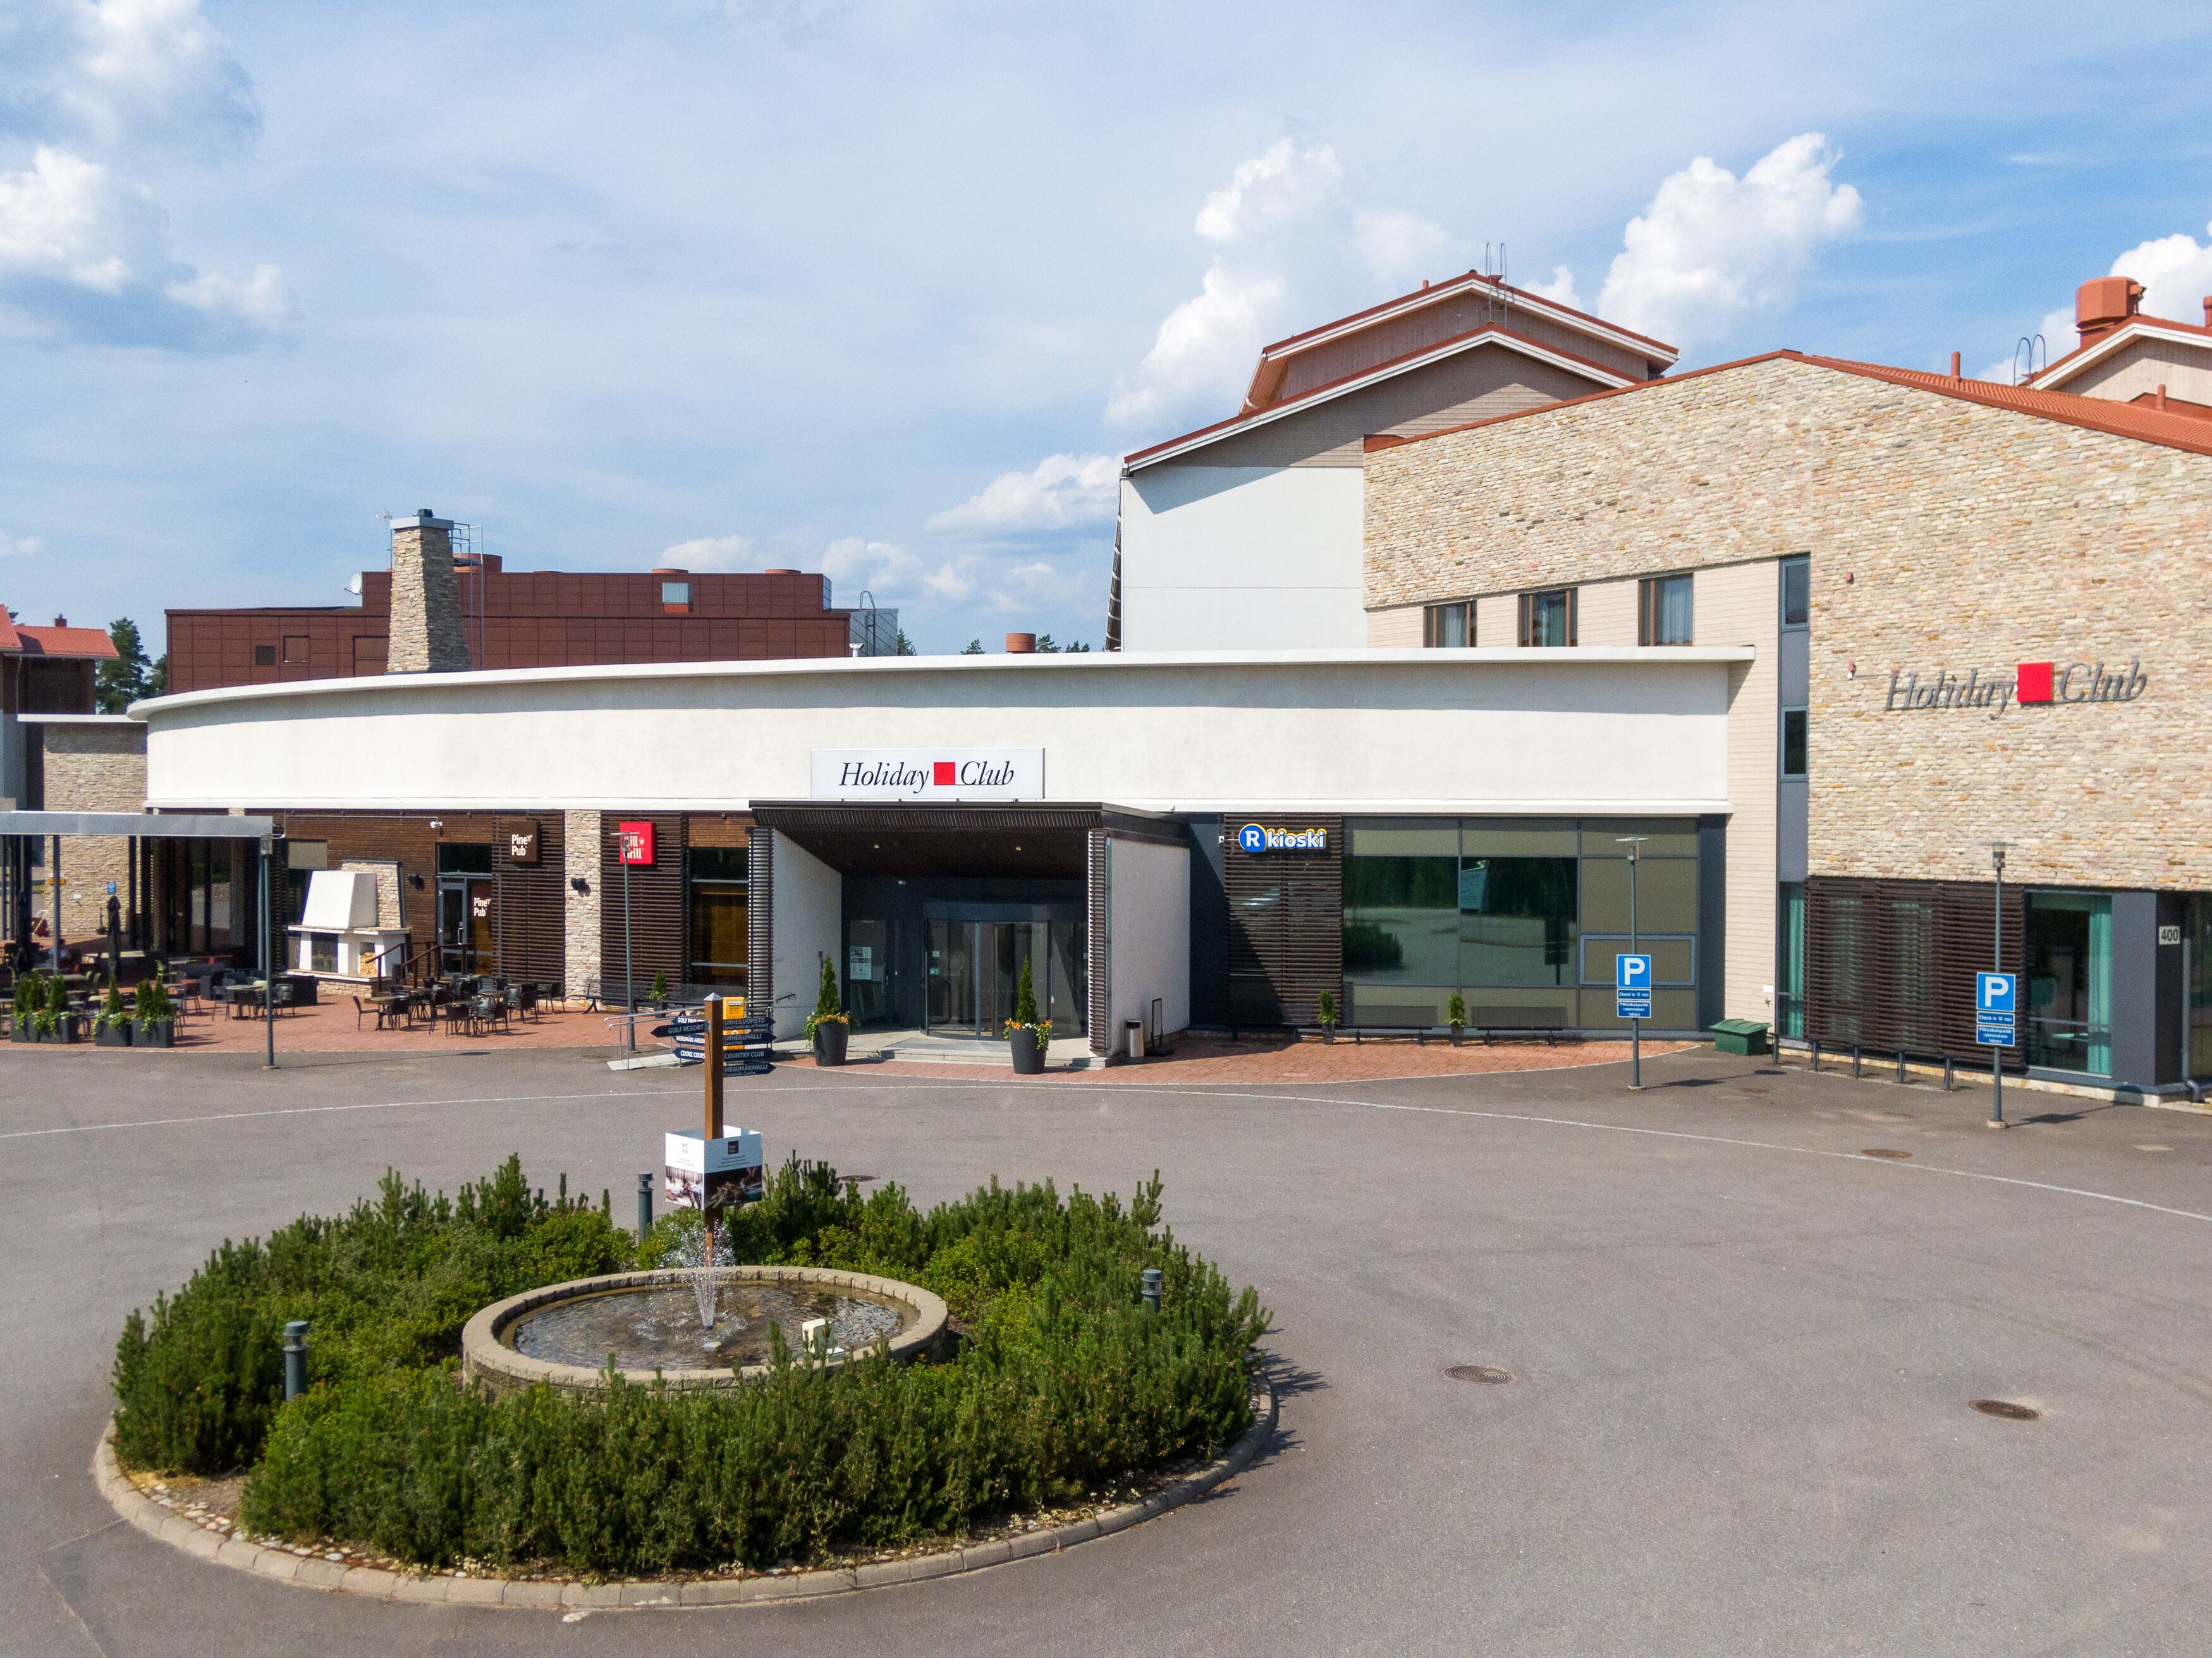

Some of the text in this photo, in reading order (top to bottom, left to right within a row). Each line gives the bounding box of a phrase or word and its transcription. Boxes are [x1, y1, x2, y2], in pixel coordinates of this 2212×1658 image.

[1883, 657, 2148, 721] Holiday Club
[838, 760, 1015, 794] Holiday Club
[511, 834, 529, 845] Pine
[623, 835, 639, 847] ill
[1245, 830, 1324, 848] R kioski
[511, 845, 526, 856] Pub
[474, 897, 487, 907] Pine
[474, 907, 486, 917] Pub
[2161, 929, 2178, 941] 400
[1624, 957, 1646, 985] P
[1985, 976, 2009, 1007] P
[724, 1064, 768, 1073] VIERUMÄKIHALLI
